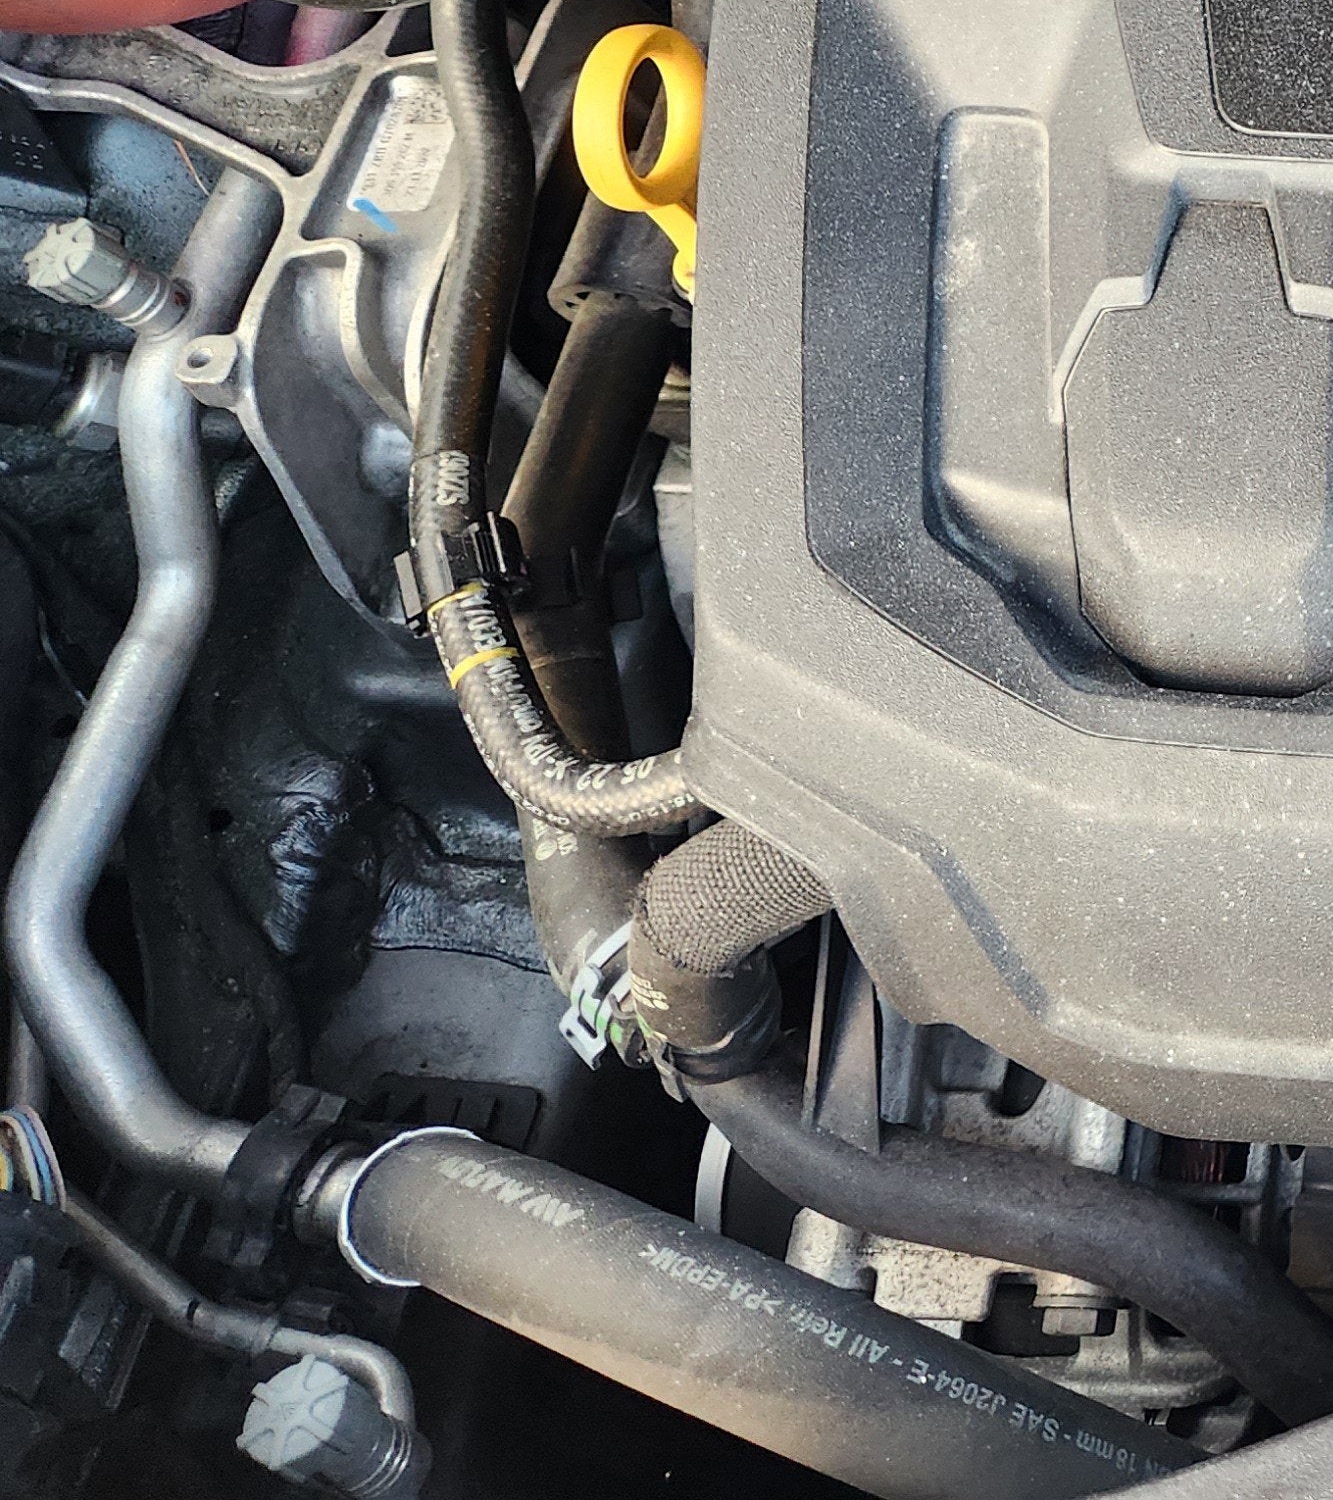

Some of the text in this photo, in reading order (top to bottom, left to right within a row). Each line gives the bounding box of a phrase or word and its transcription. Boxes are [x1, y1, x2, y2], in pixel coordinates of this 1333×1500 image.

[846, 1331, 892, 1366] All
[906, 1359, 1007, 1417] J2064-E
[1009, 1406, 1061, 1443] SAE
